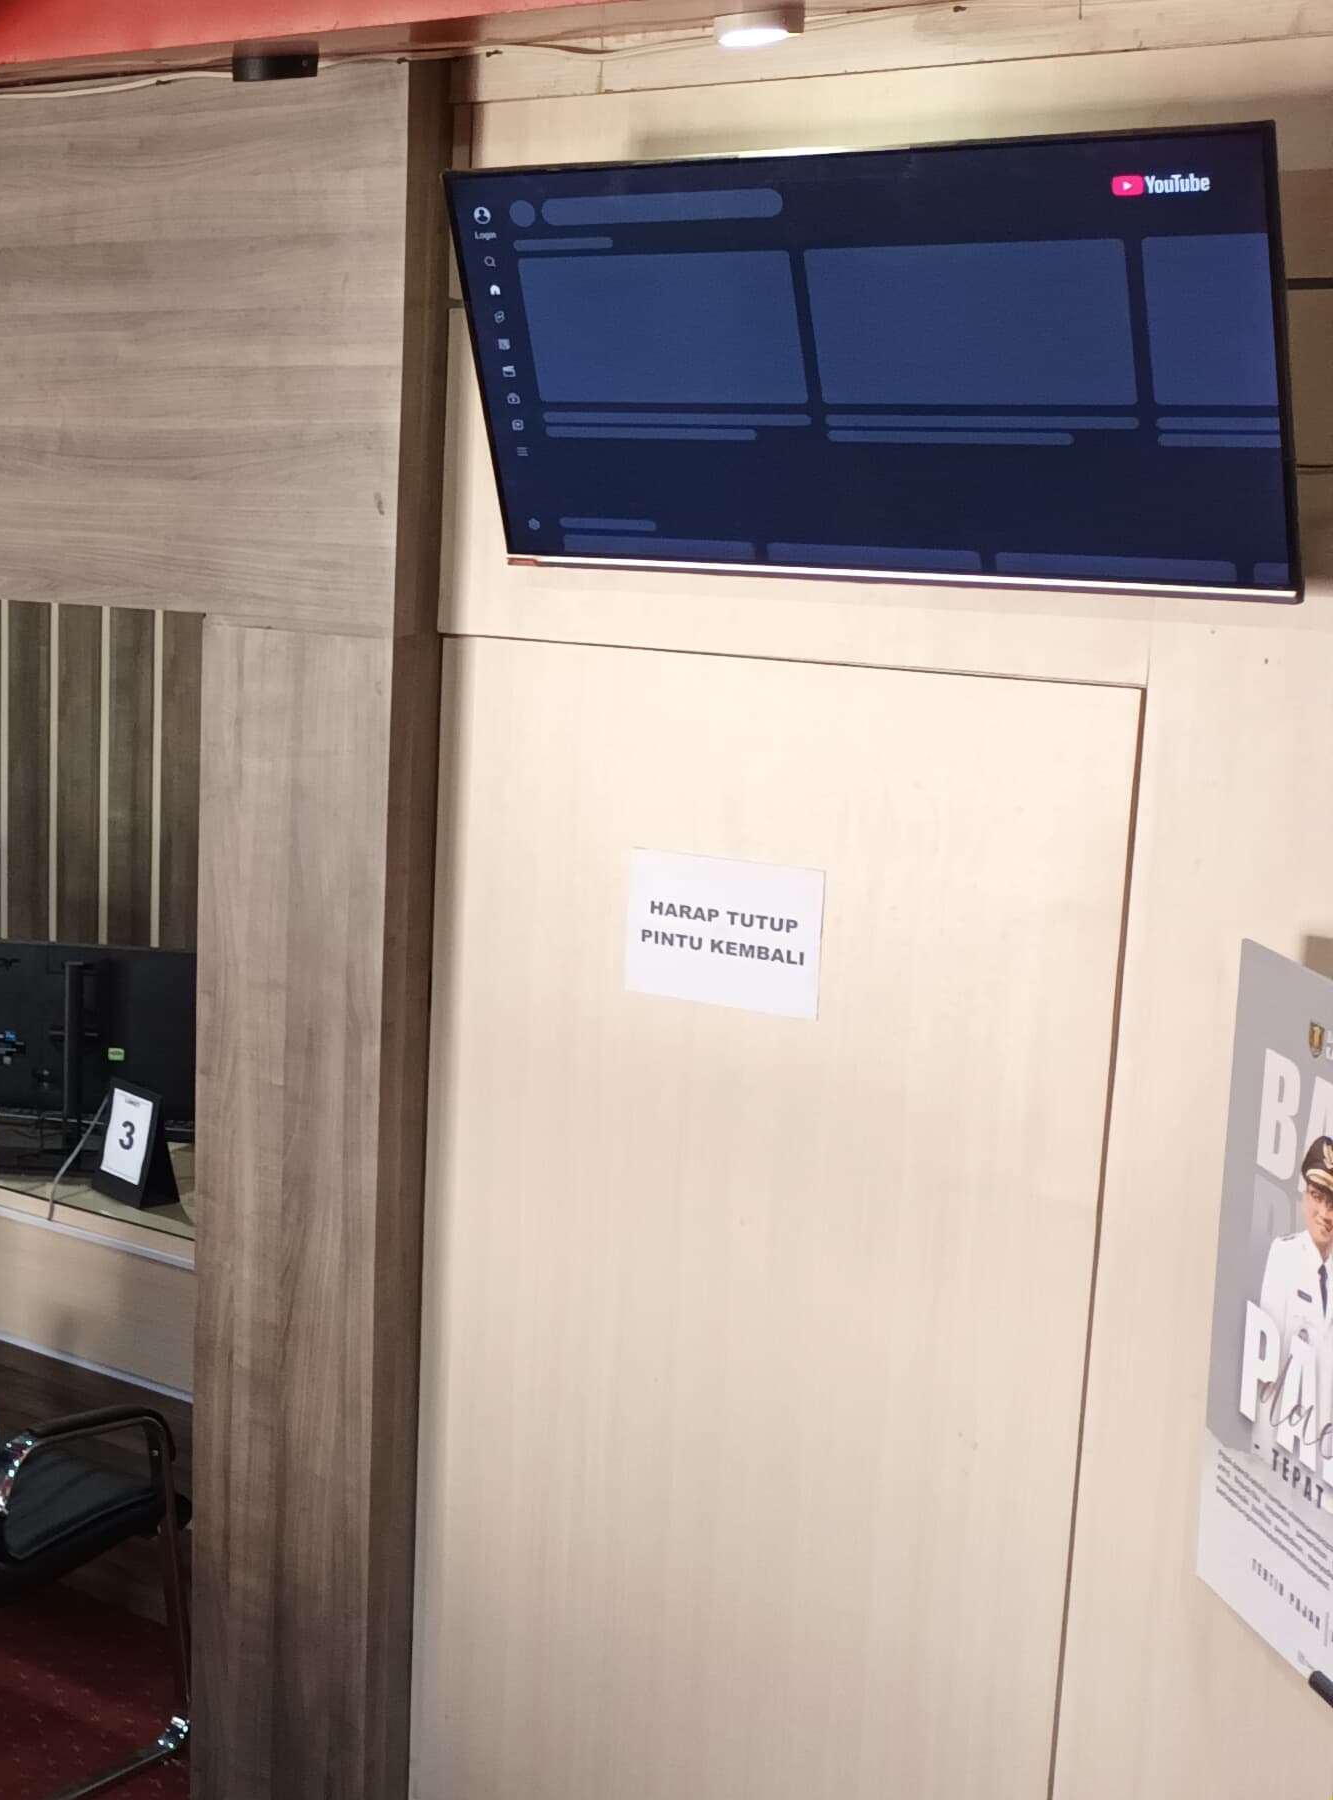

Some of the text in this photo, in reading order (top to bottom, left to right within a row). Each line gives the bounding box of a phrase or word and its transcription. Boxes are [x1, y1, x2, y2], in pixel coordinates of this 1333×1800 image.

[1144, 173, 1211, 194] YouTube
[474, 231, 498, 241] Login
[650, 900, 799, 934] HARAP TUTUP
[641, 929, 806, 967] PINTU KEMBALI
[118, 1120, 136, 1151] 3
[1271, 1447, 1324, 1510] TEPAT
